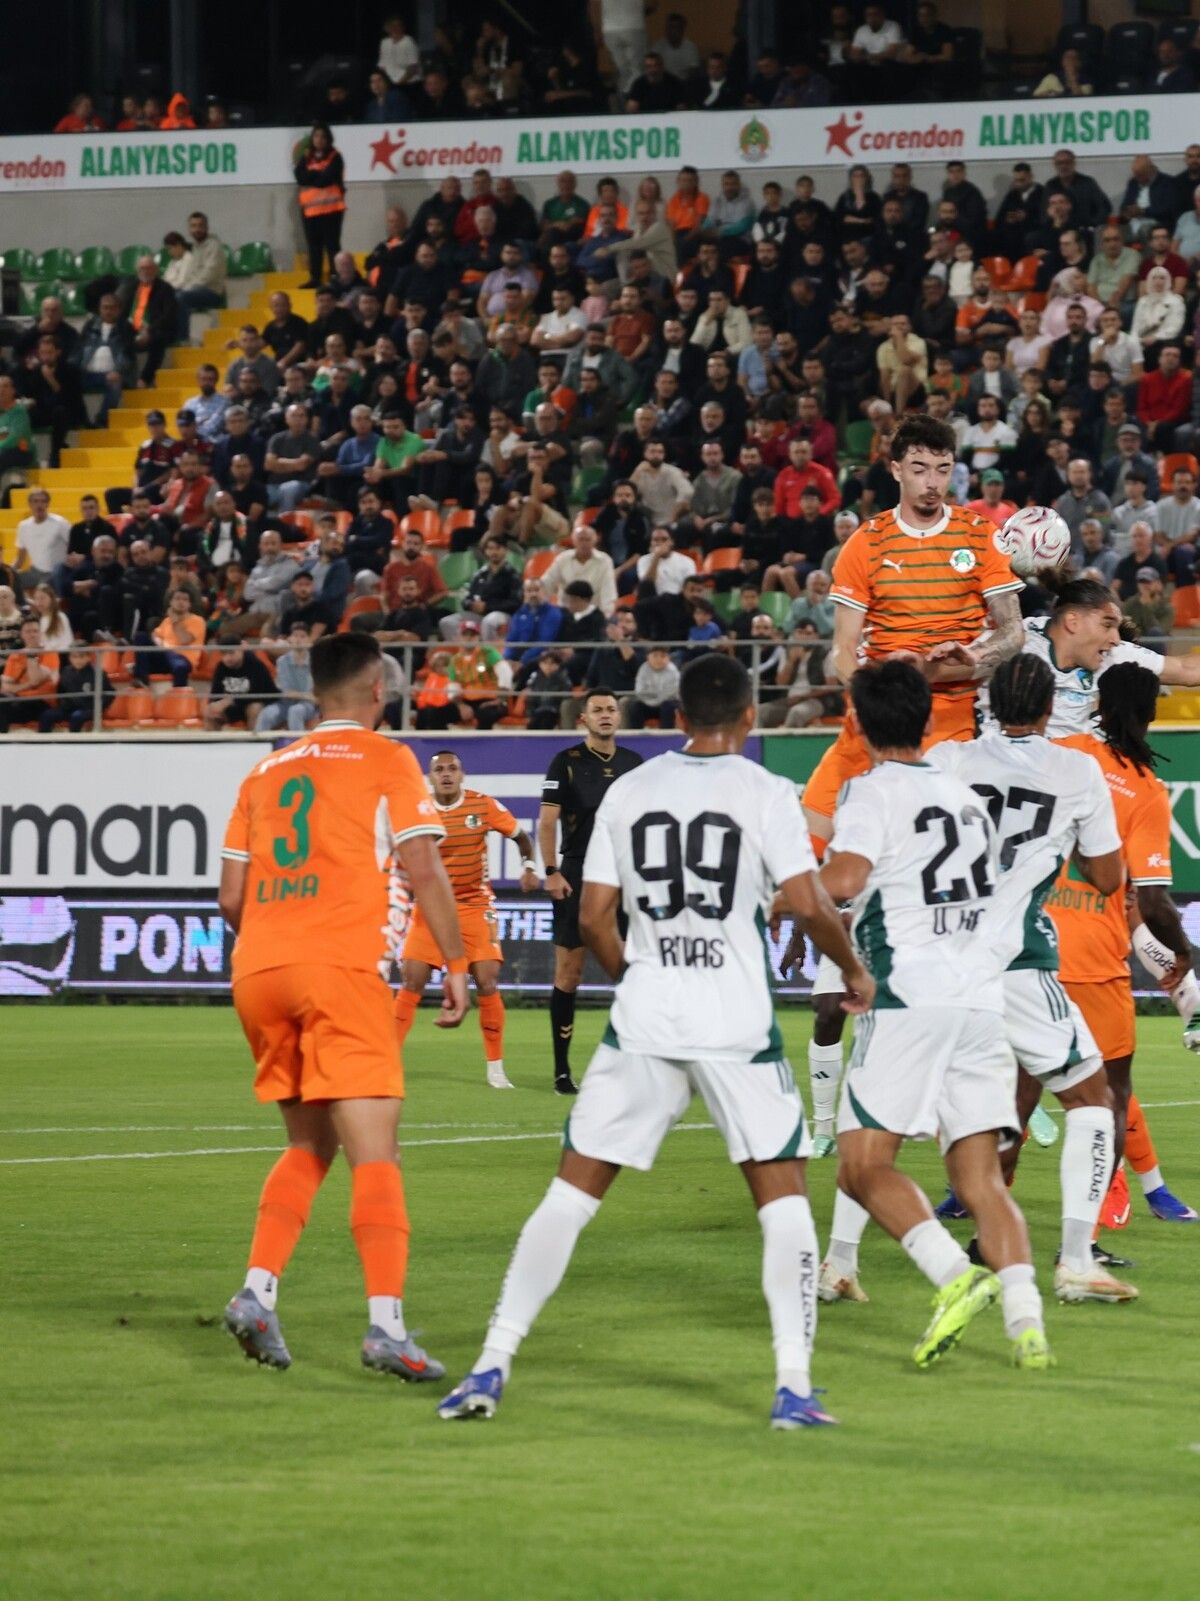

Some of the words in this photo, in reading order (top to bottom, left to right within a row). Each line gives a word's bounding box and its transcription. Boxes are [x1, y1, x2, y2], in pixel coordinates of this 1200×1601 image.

[517, 127, 681, 164] ALANYASPOR
[859, 123, 964, 152] corendon
[979, 109, 1151, 148] ALANYASPOR
[80, 143, 238, 177] ALANYASPOR
[402, 140, 502, 167] corendon
[0, 803, 208, 877] man
[274, 775, 316, 869] 3
[631, 811, 742, 921] 99
[914, 805, 995, 906] 22
[256, 874, 319, 904] LIMA
[660, 933, 725, 968] RIVAS
